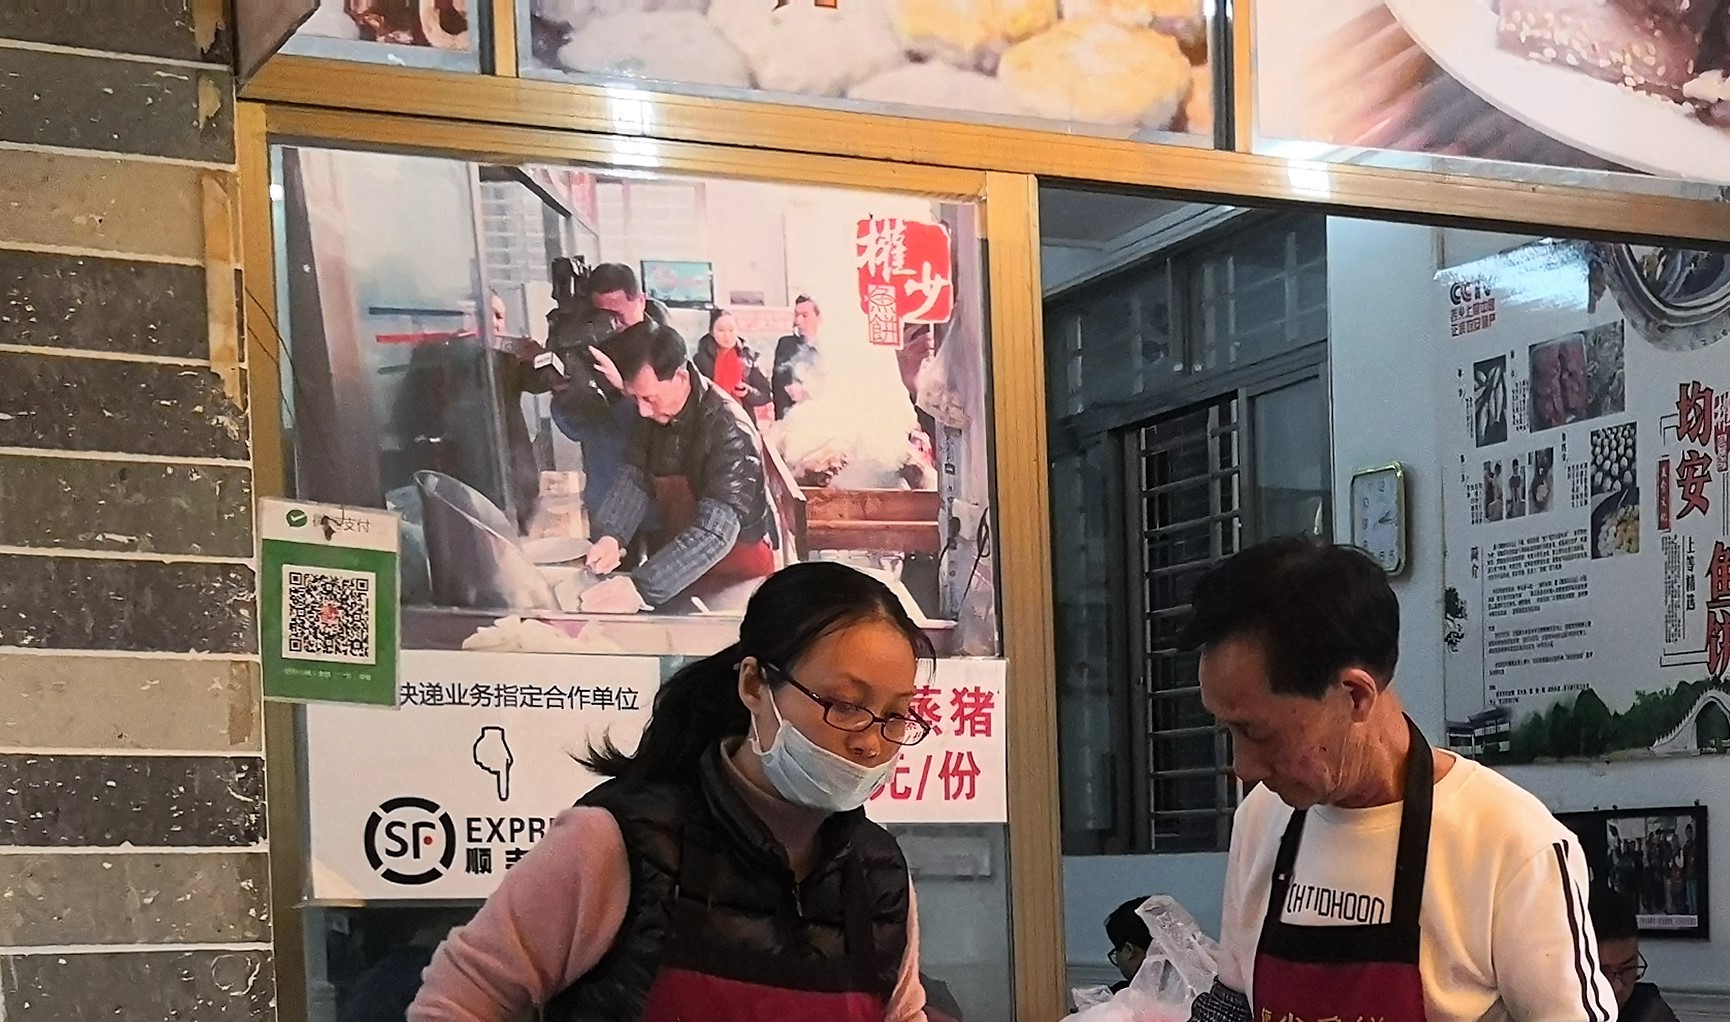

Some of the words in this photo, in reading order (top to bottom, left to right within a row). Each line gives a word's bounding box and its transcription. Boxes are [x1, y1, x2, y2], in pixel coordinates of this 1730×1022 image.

[1675, 380, 1713, 520] 均安
[384, 820, 436, 859] SF
[466, 817, 556, 844] EXPR
